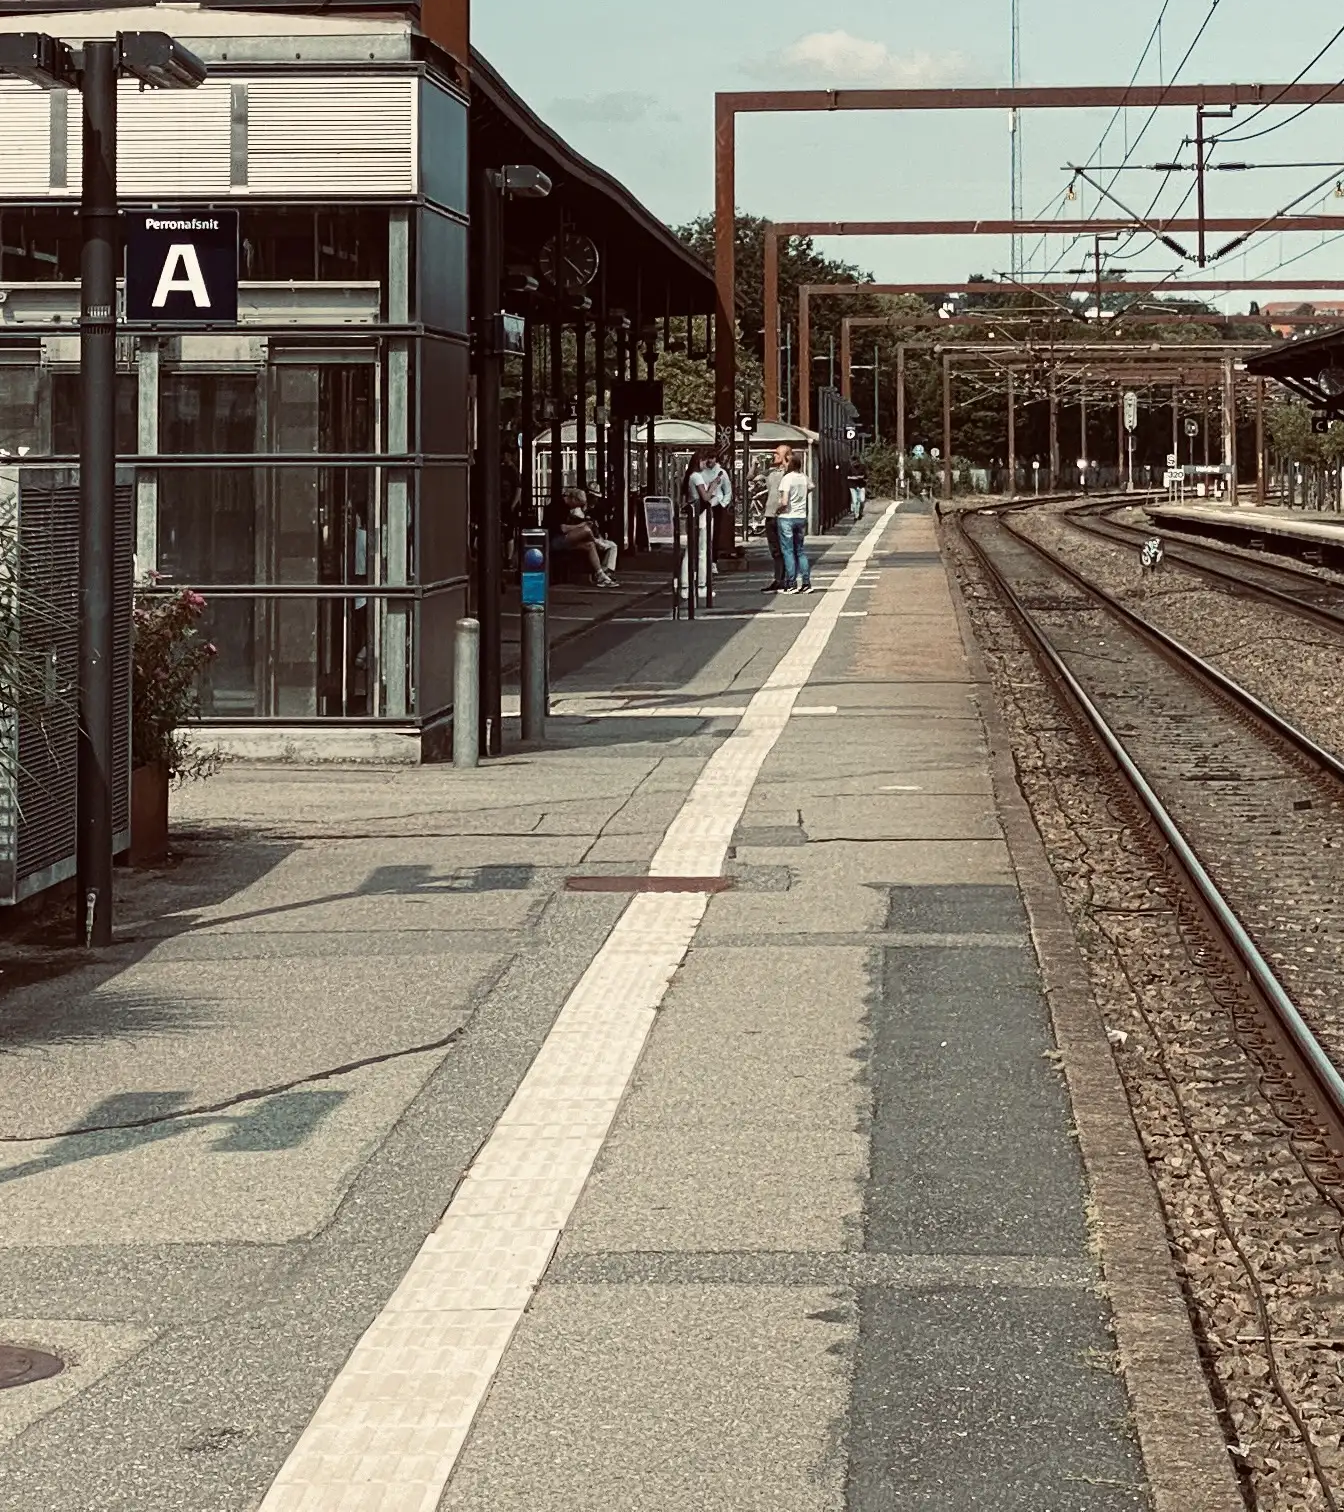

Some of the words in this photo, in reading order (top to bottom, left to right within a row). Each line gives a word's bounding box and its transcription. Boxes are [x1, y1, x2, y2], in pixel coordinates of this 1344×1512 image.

[145, 218, 219, 230] Perronafsnit
[151, 244, 212, 308] A
[740, 416, 753, 431] C
